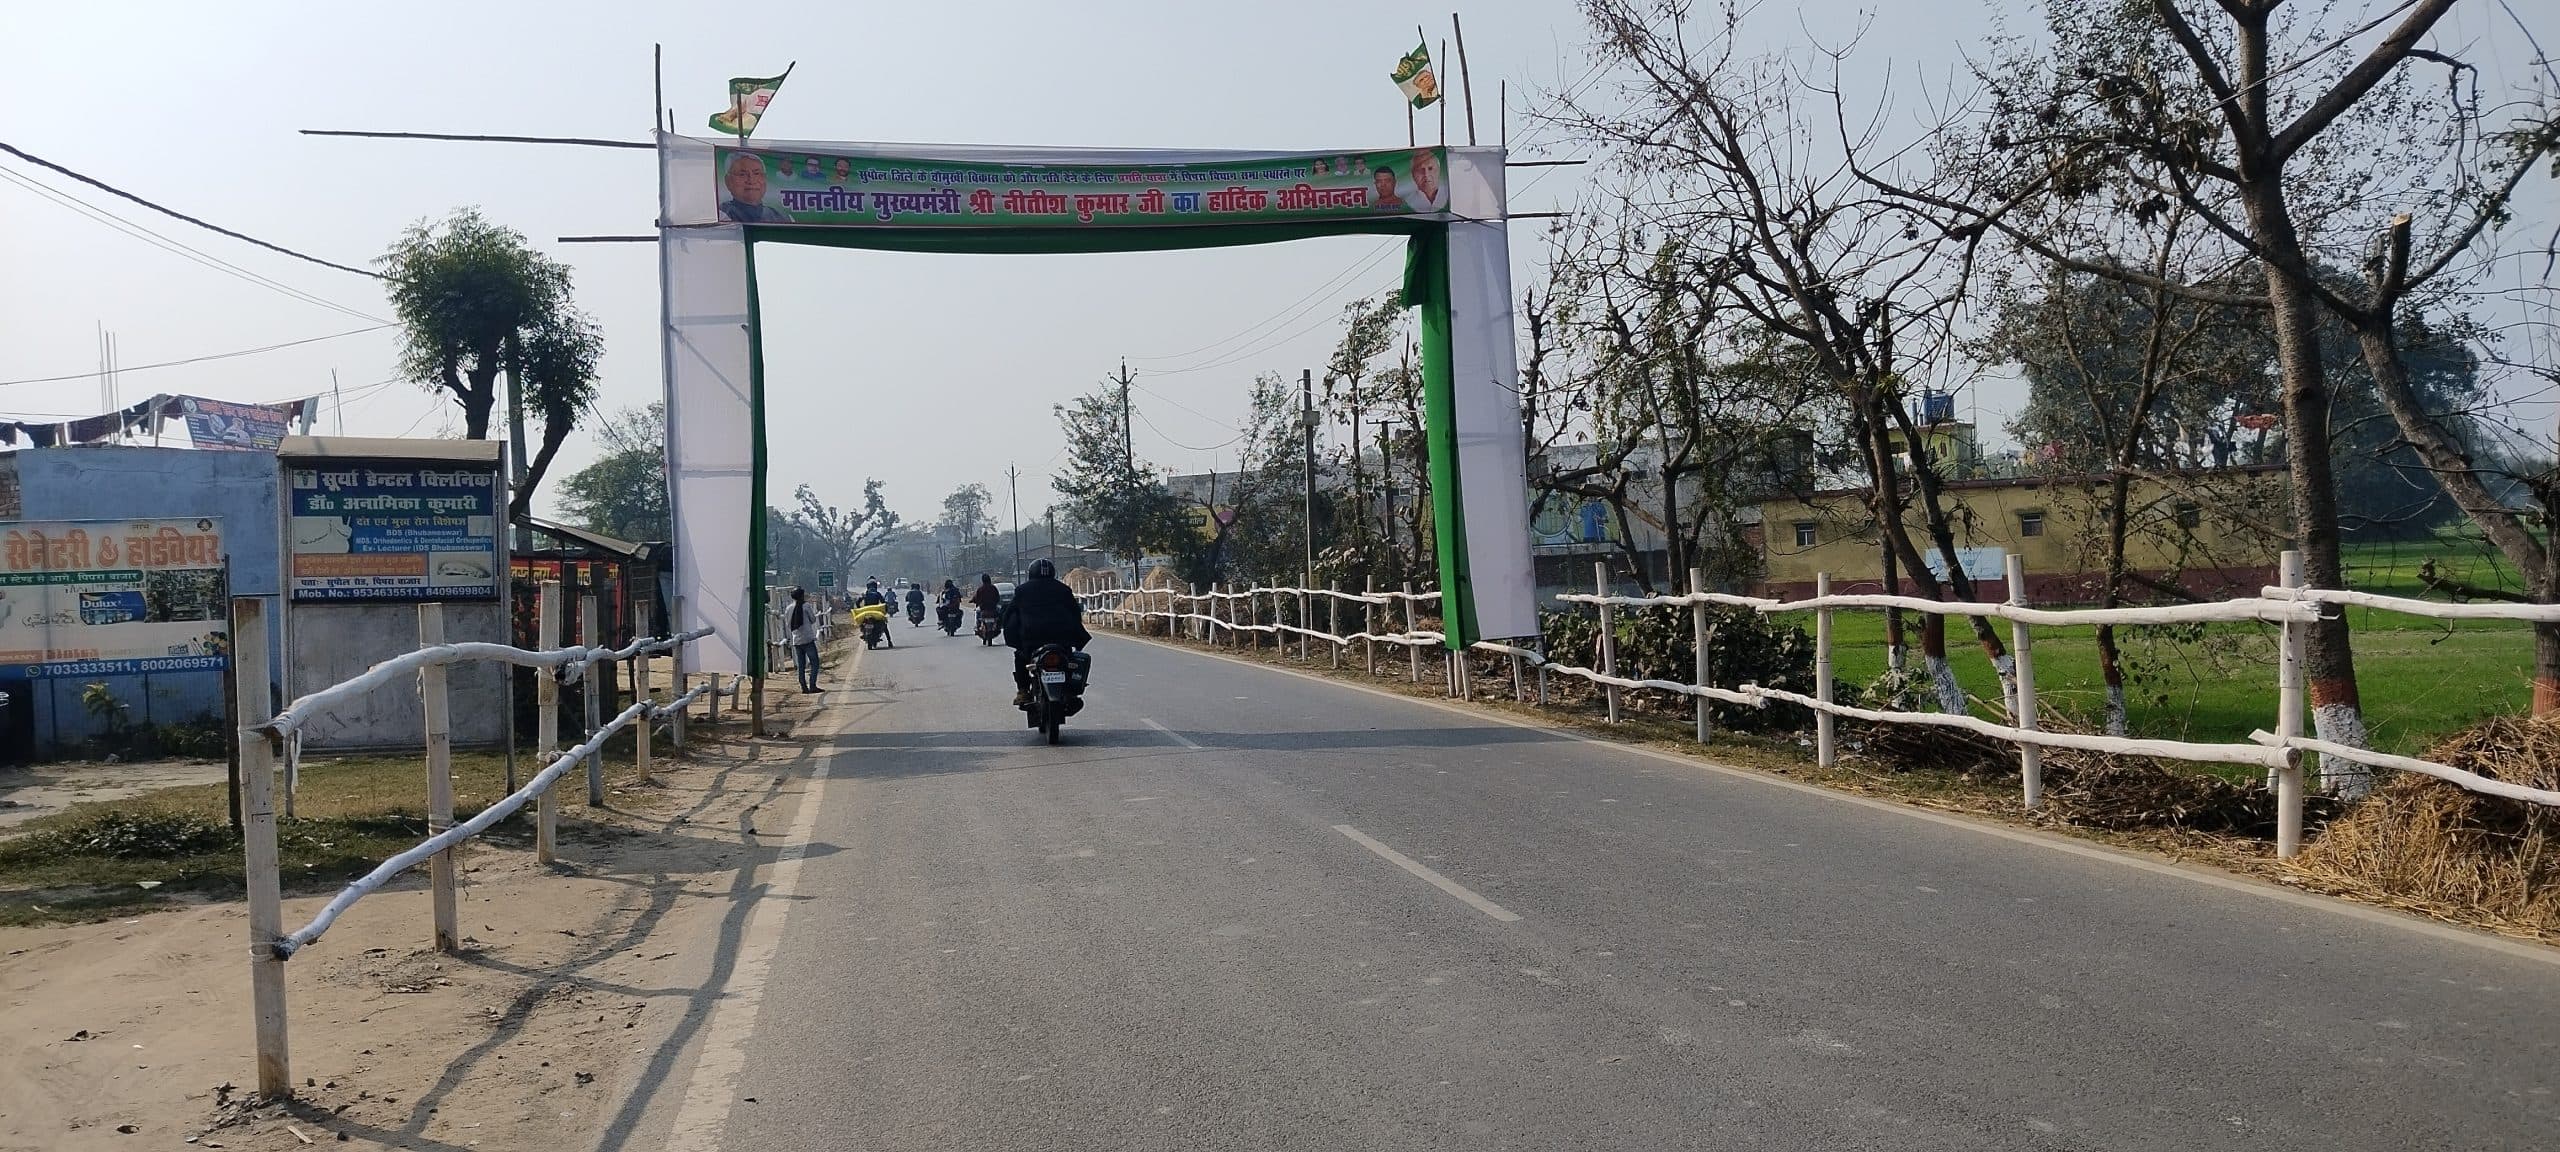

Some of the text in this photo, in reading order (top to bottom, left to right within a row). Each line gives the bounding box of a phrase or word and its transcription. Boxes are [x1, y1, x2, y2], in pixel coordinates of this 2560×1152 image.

[890, 168, 914, 182] जिले
[917, 169, 928, 182] के
[967, 171, 999, 183] विकास
[1002, 171, 1017, 183] को
[1020, 171, 1038, 183] और
[1041, 171, 1060, 183] गति
[1081, 172, 1093, 183] के
[1094, 171, 1114, 183] लिए
[1168, 170, 1179, 182] में
[1293, 167, 1306, 179] पर
[779, 182, 1370, 222] माननीय मुख्यमंत्री श्री नीतीश कुमार जी का हार्दिक अभिनन्दन
[364, 469, 413, 488] डेन्टल
[419, 469, 492, 488] क्लिनिक
[343, 494, 422, 511] अनामिका
[425, 494, 479, 514] कुमारी
[96, 536, 120, 568] &
[299, 589, 325, 598] Mob.
[82, 600, 118, 609] Dulux
[44, 657, 225, 676] 7033333511, 8002069571
